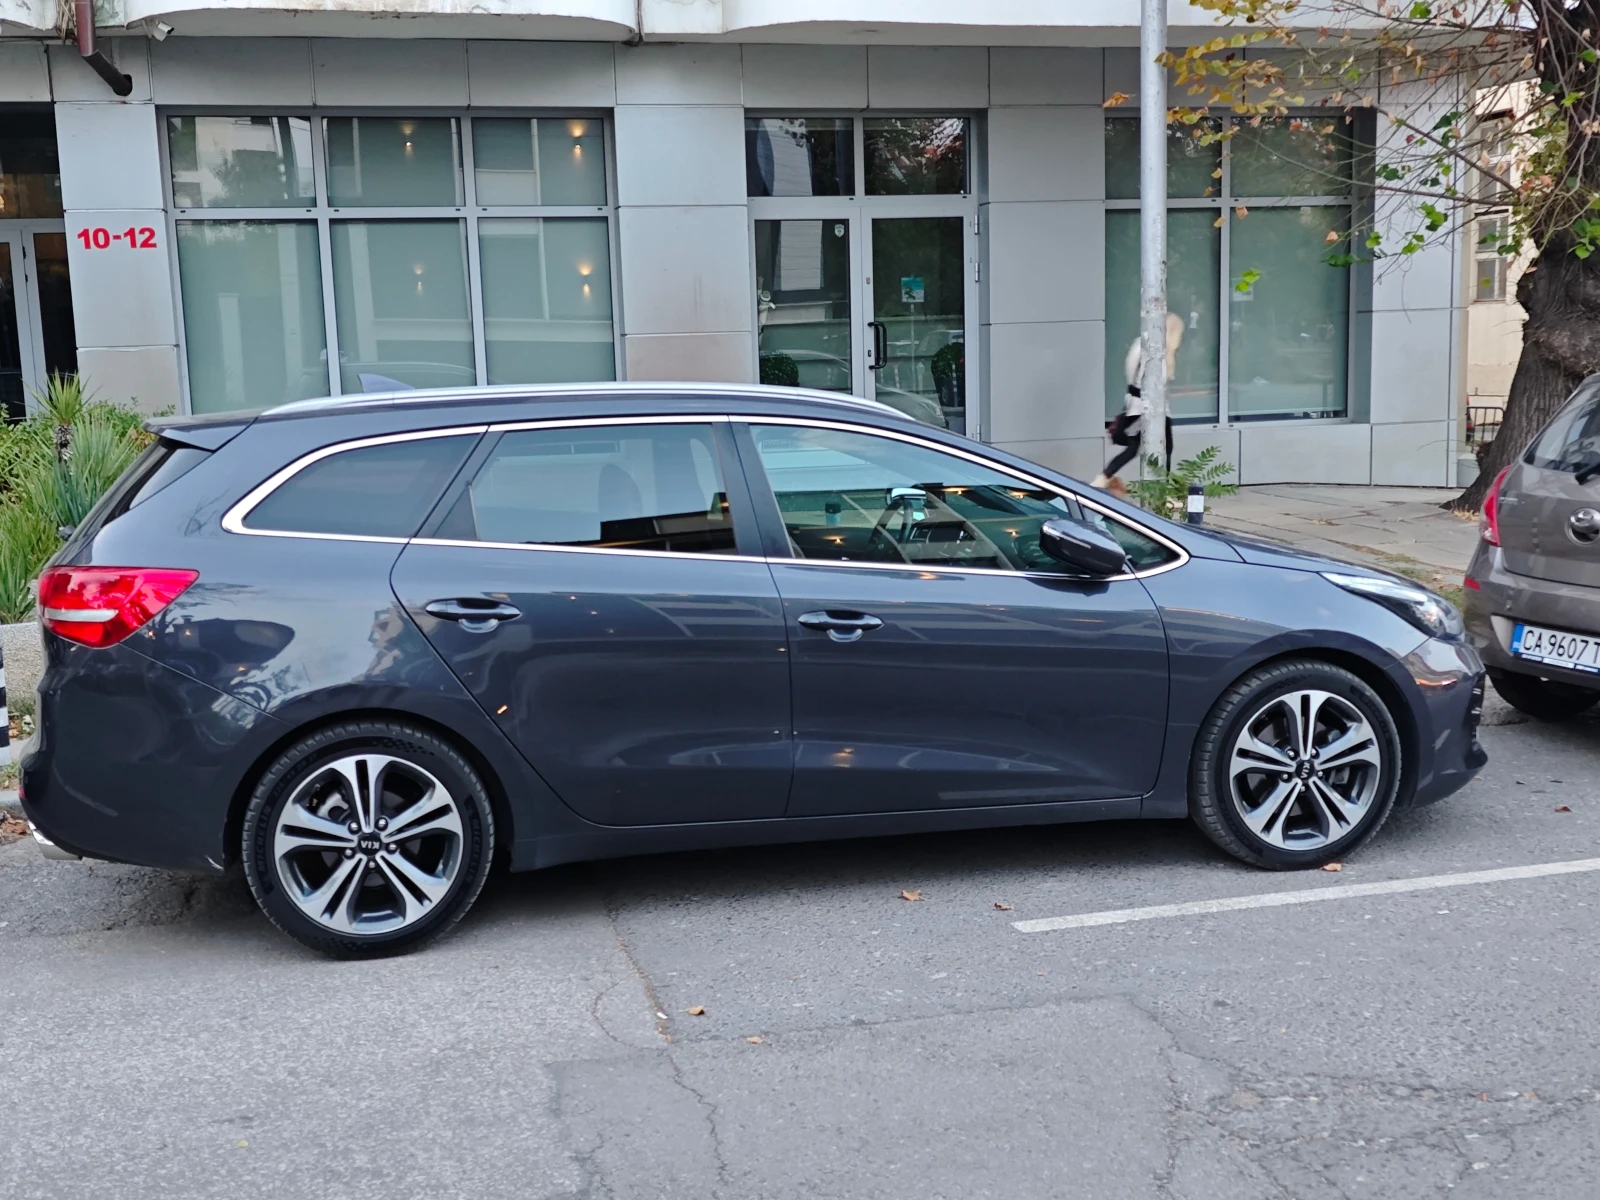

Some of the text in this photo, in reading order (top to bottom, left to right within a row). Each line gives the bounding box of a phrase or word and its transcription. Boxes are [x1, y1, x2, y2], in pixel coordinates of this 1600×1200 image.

[77, 227, 157, 250] 10-12
[1523, 629, 1543, 653] CA
[1548, 634, 1589, 661] 9607
[1300, 761, 1311, 779] KIA
[258, 805, 272, 872] MICHELIN
[360, 840, 380, 850] KIA
